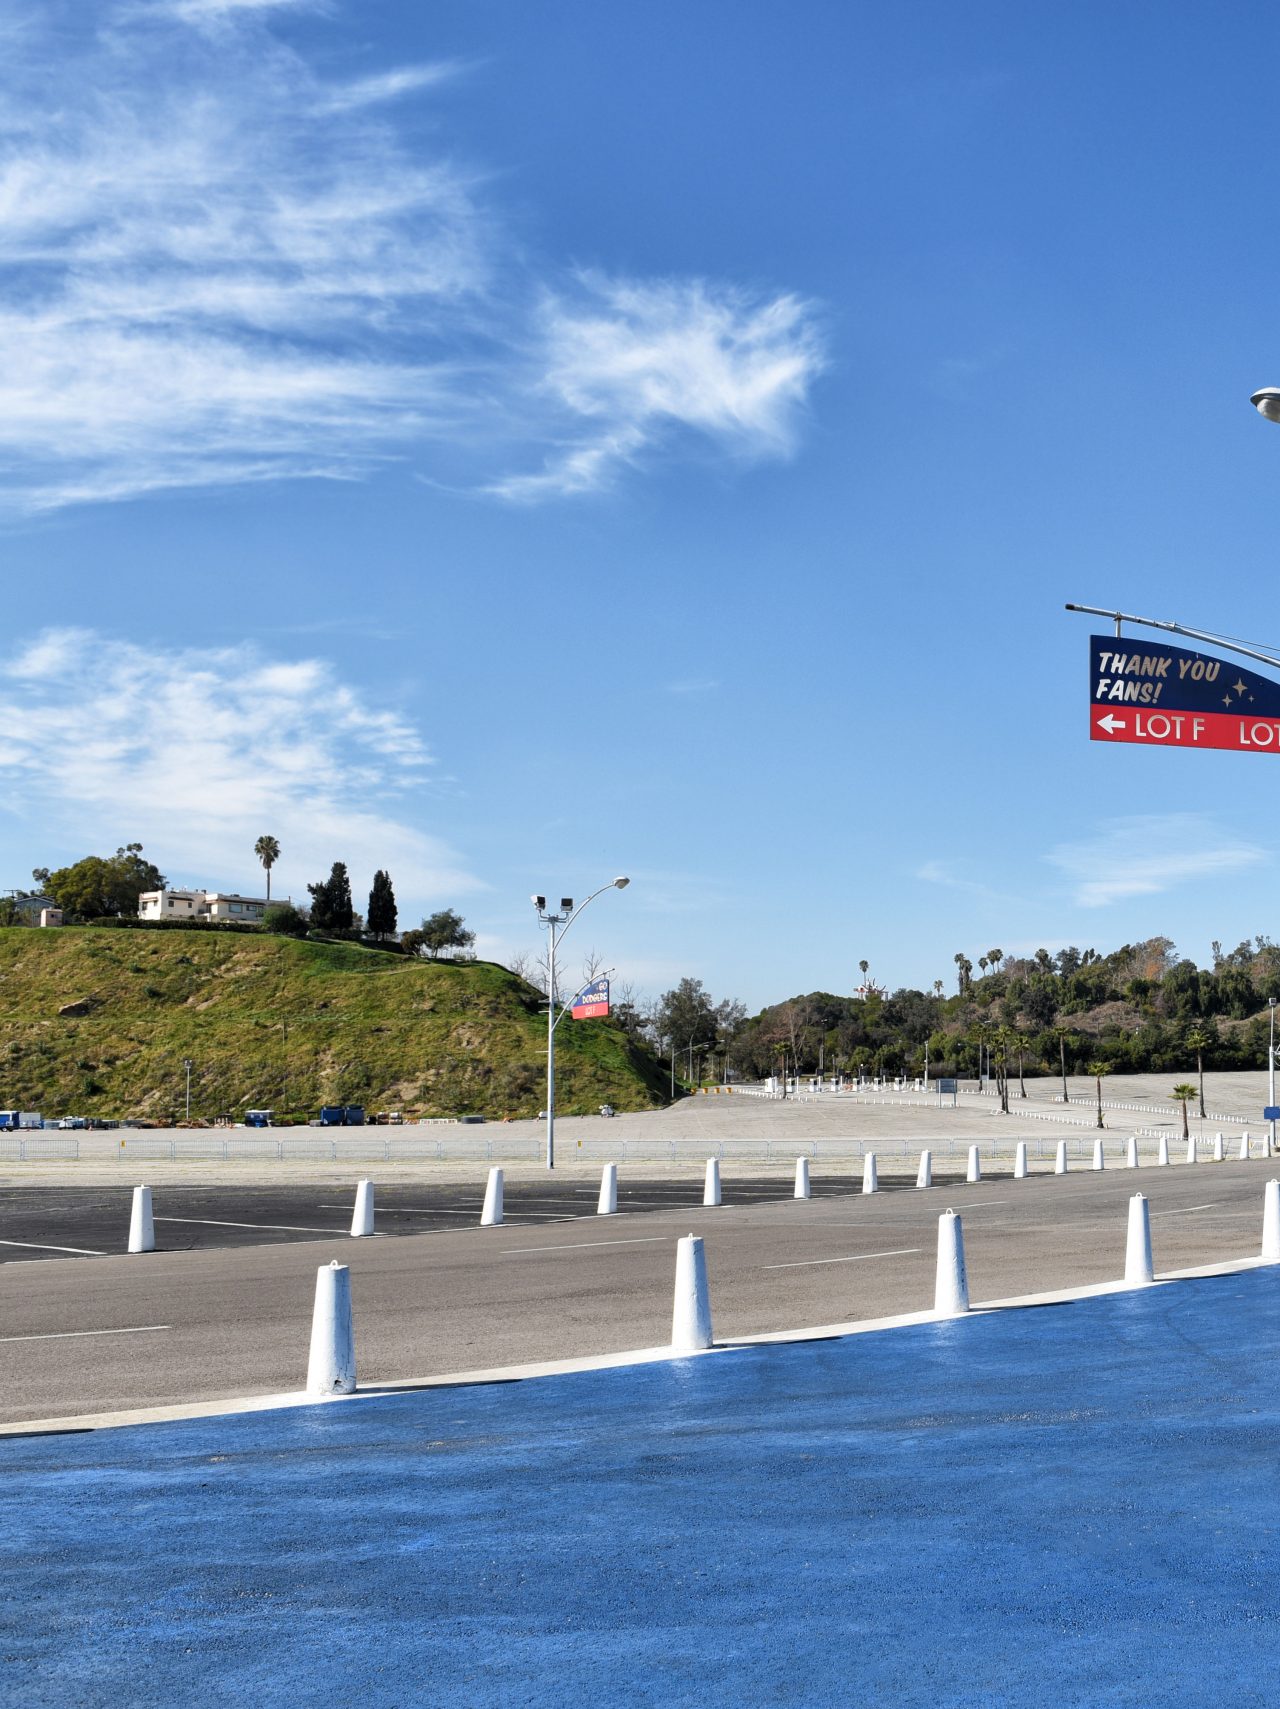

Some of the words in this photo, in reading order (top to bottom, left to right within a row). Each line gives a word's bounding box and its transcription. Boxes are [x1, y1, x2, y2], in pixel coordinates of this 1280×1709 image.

[1098, 652, 1172, 678] THANK
[1178, 658, 1220, 682] YOU
[1095, 679, 1163, 704] FANS!
[1135, 713, 1185, 739] LOT
[1193, 718, 1205, 740] F
